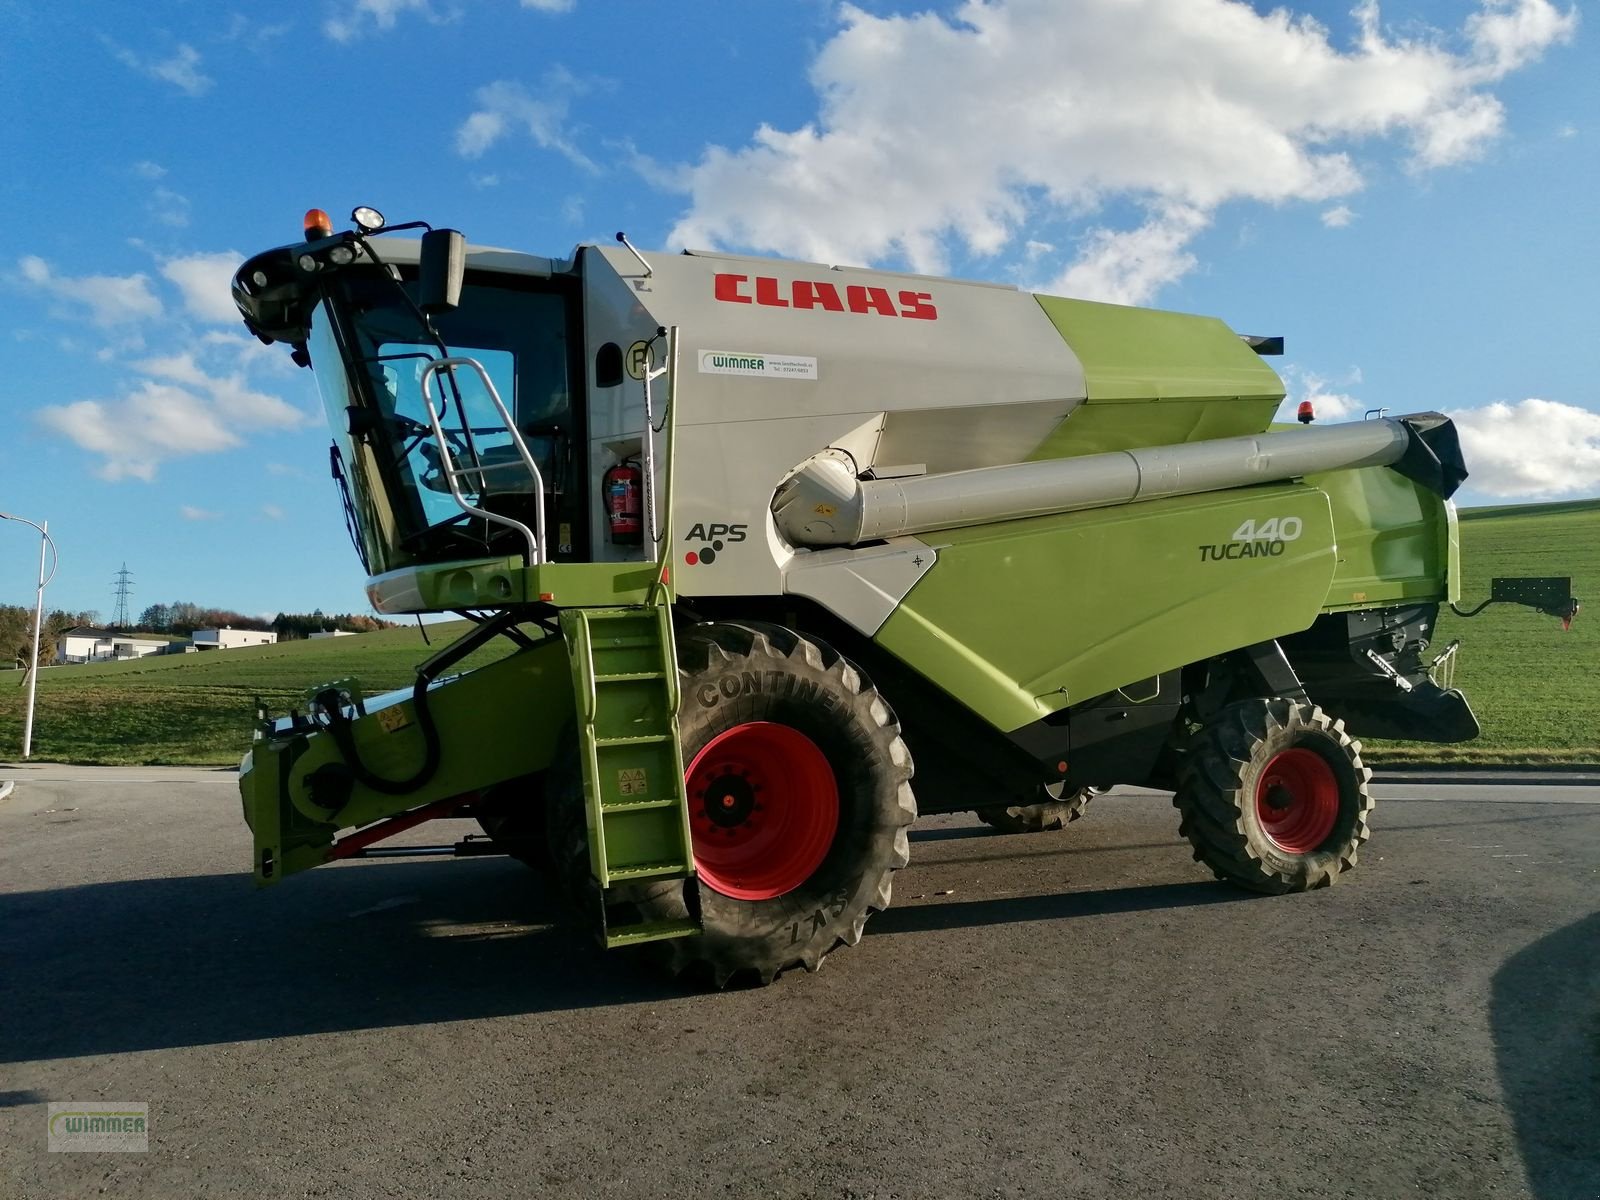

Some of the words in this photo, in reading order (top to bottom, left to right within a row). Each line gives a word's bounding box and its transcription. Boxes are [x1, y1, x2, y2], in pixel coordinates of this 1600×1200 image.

[715, 273, 938, 320] CLAAS
[712, 356, 765, 370] WIMMER
[684, 523, 748, 542] APS
[1232, 516, 1303, 543] 440
[1198, 540, 1285, 561] TUCANO
